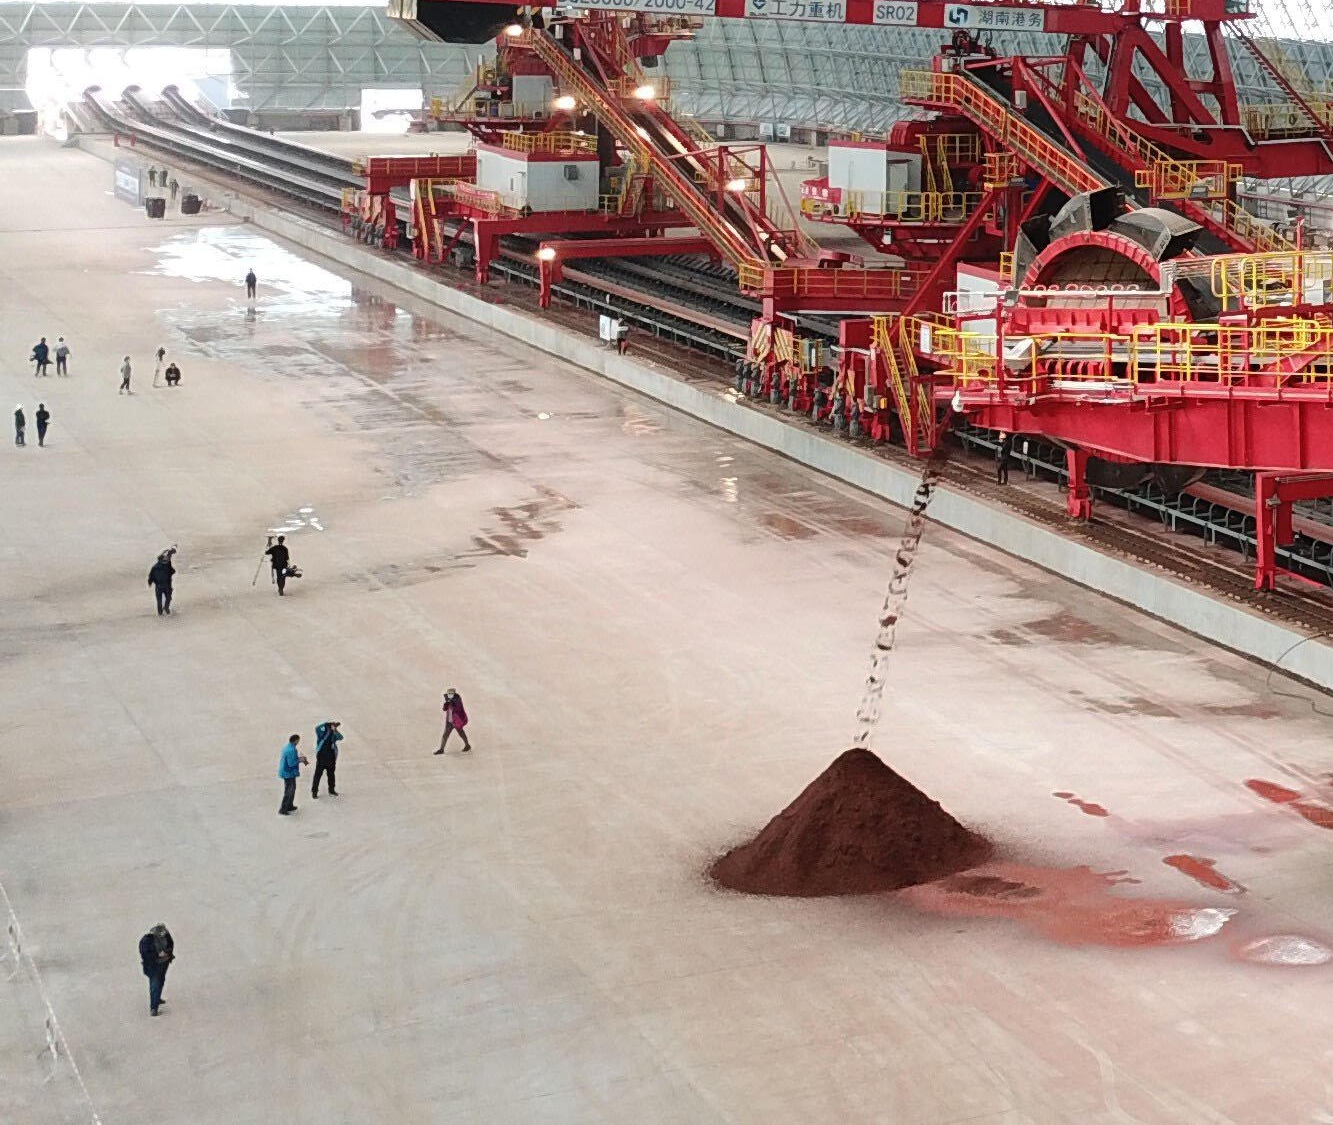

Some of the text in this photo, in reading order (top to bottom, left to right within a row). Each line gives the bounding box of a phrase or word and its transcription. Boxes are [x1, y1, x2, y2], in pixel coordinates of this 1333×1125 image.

[769, 0, 843, 19] 工力重机
[876, 5, 915, 21] SR02
[978, 9, 1042, 28] 湖南港务
